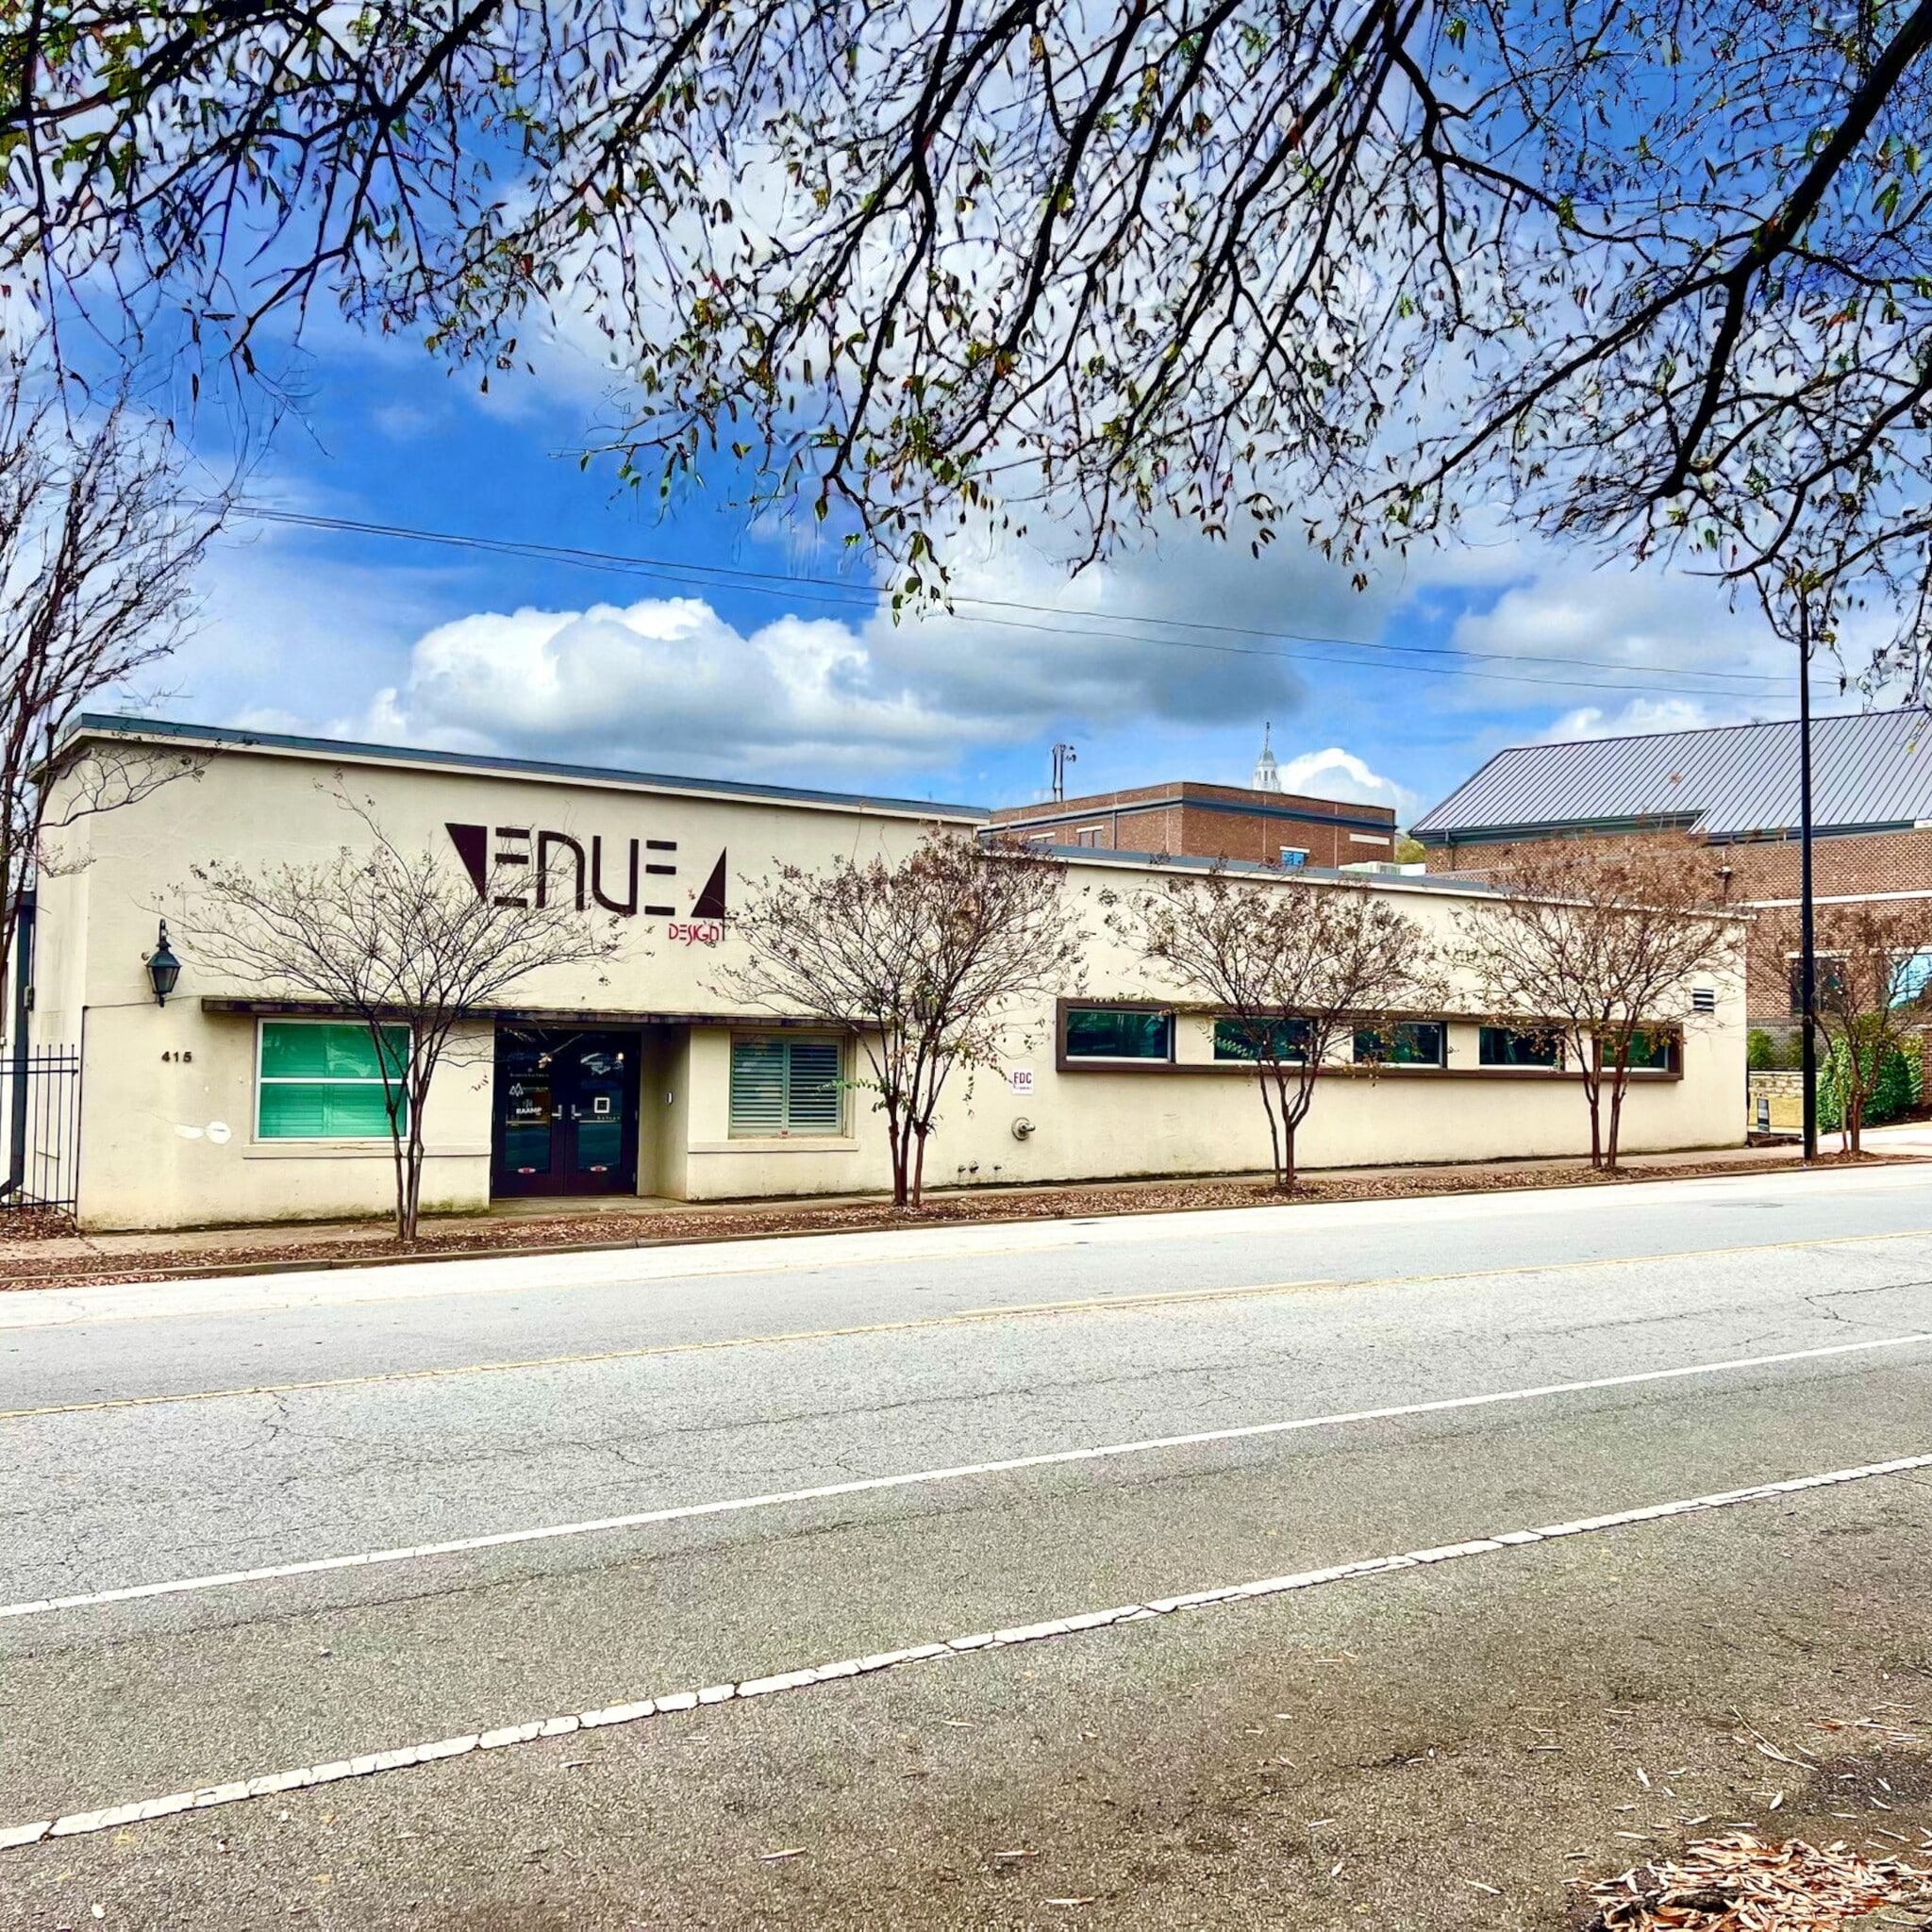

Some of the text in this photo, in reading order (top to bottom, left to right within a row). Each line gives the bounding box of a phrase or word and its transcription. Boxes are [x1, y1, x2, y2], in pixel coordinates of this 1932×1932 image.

[668, 923, 720, 947] DESIGN
[161, 1051, 192, 1063] 415
[1013, 1072, 1032, 1084] FDC
